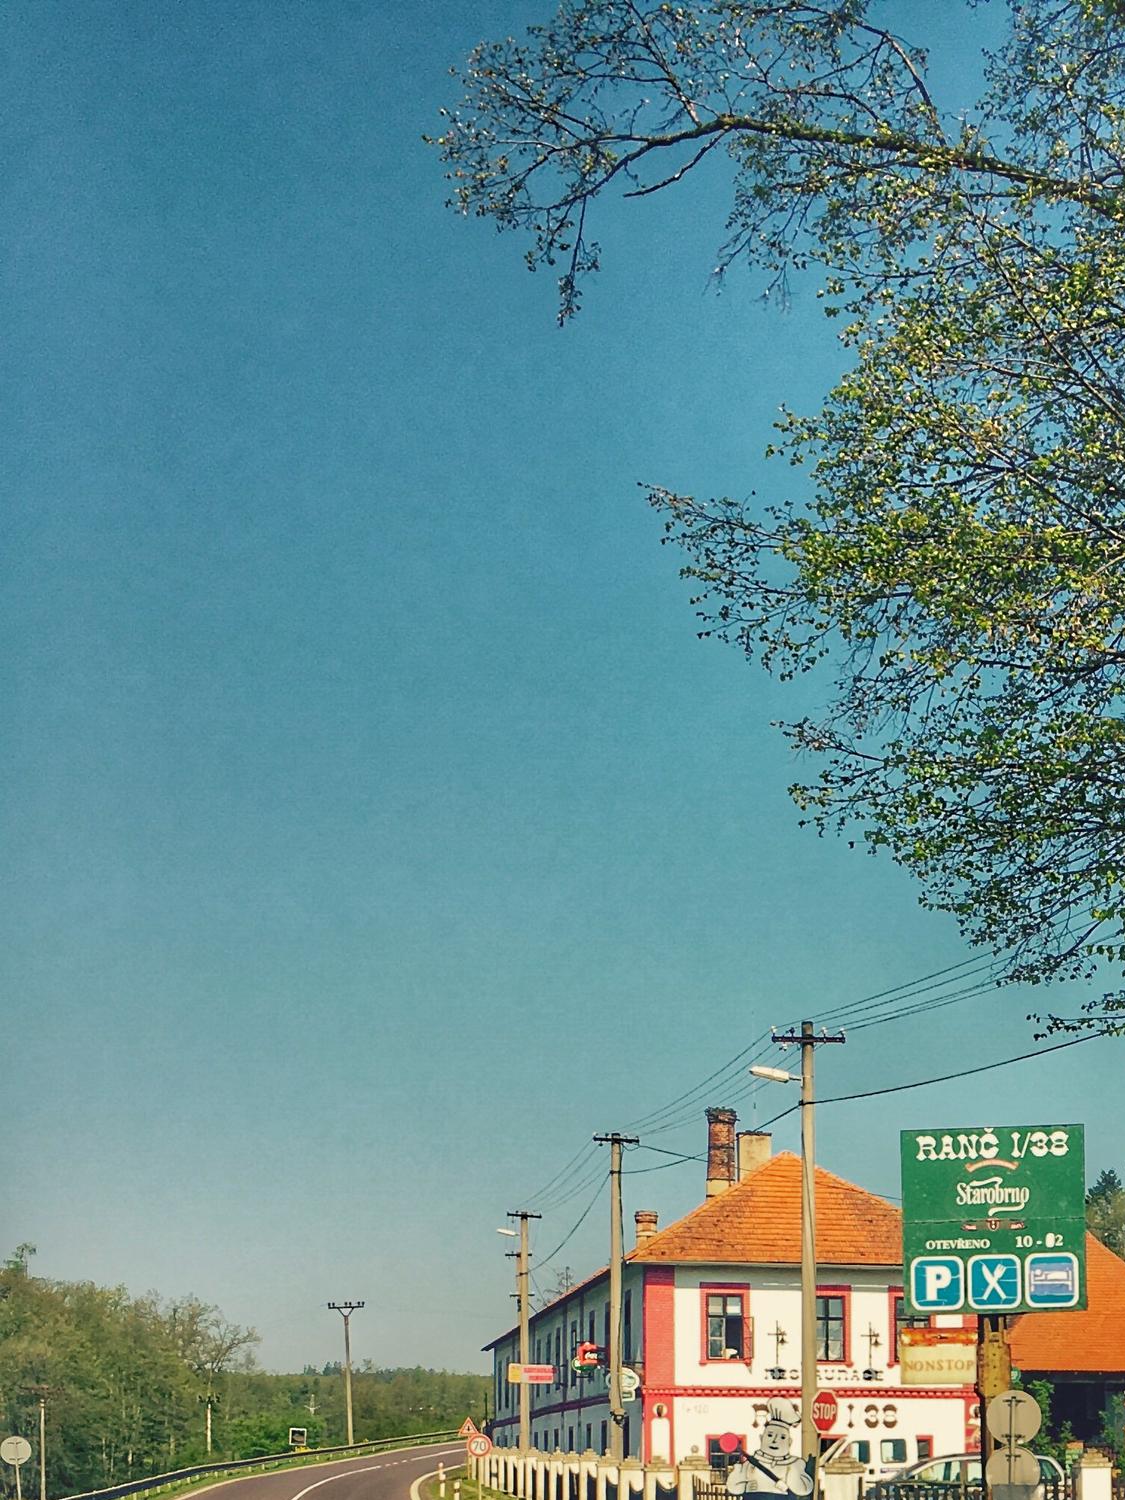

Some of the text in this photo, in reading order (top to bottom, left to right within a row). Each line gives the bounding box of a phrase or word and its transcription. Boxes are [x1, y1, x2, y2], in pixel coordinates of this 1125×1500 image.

[915, 1127, 1069, 1161] RANČ 1/38
[956, 1176, 1030, 1217] Starobrno
[925, 1237, 991, 1250] OTEVŘENO
[1015, 1235, 1033, 1248] 10
[903, 1359, 975, 1372] NONSTOP
[813, 1402, 837, 1420] STOP
[472, 1440, 487, 1451] 70
